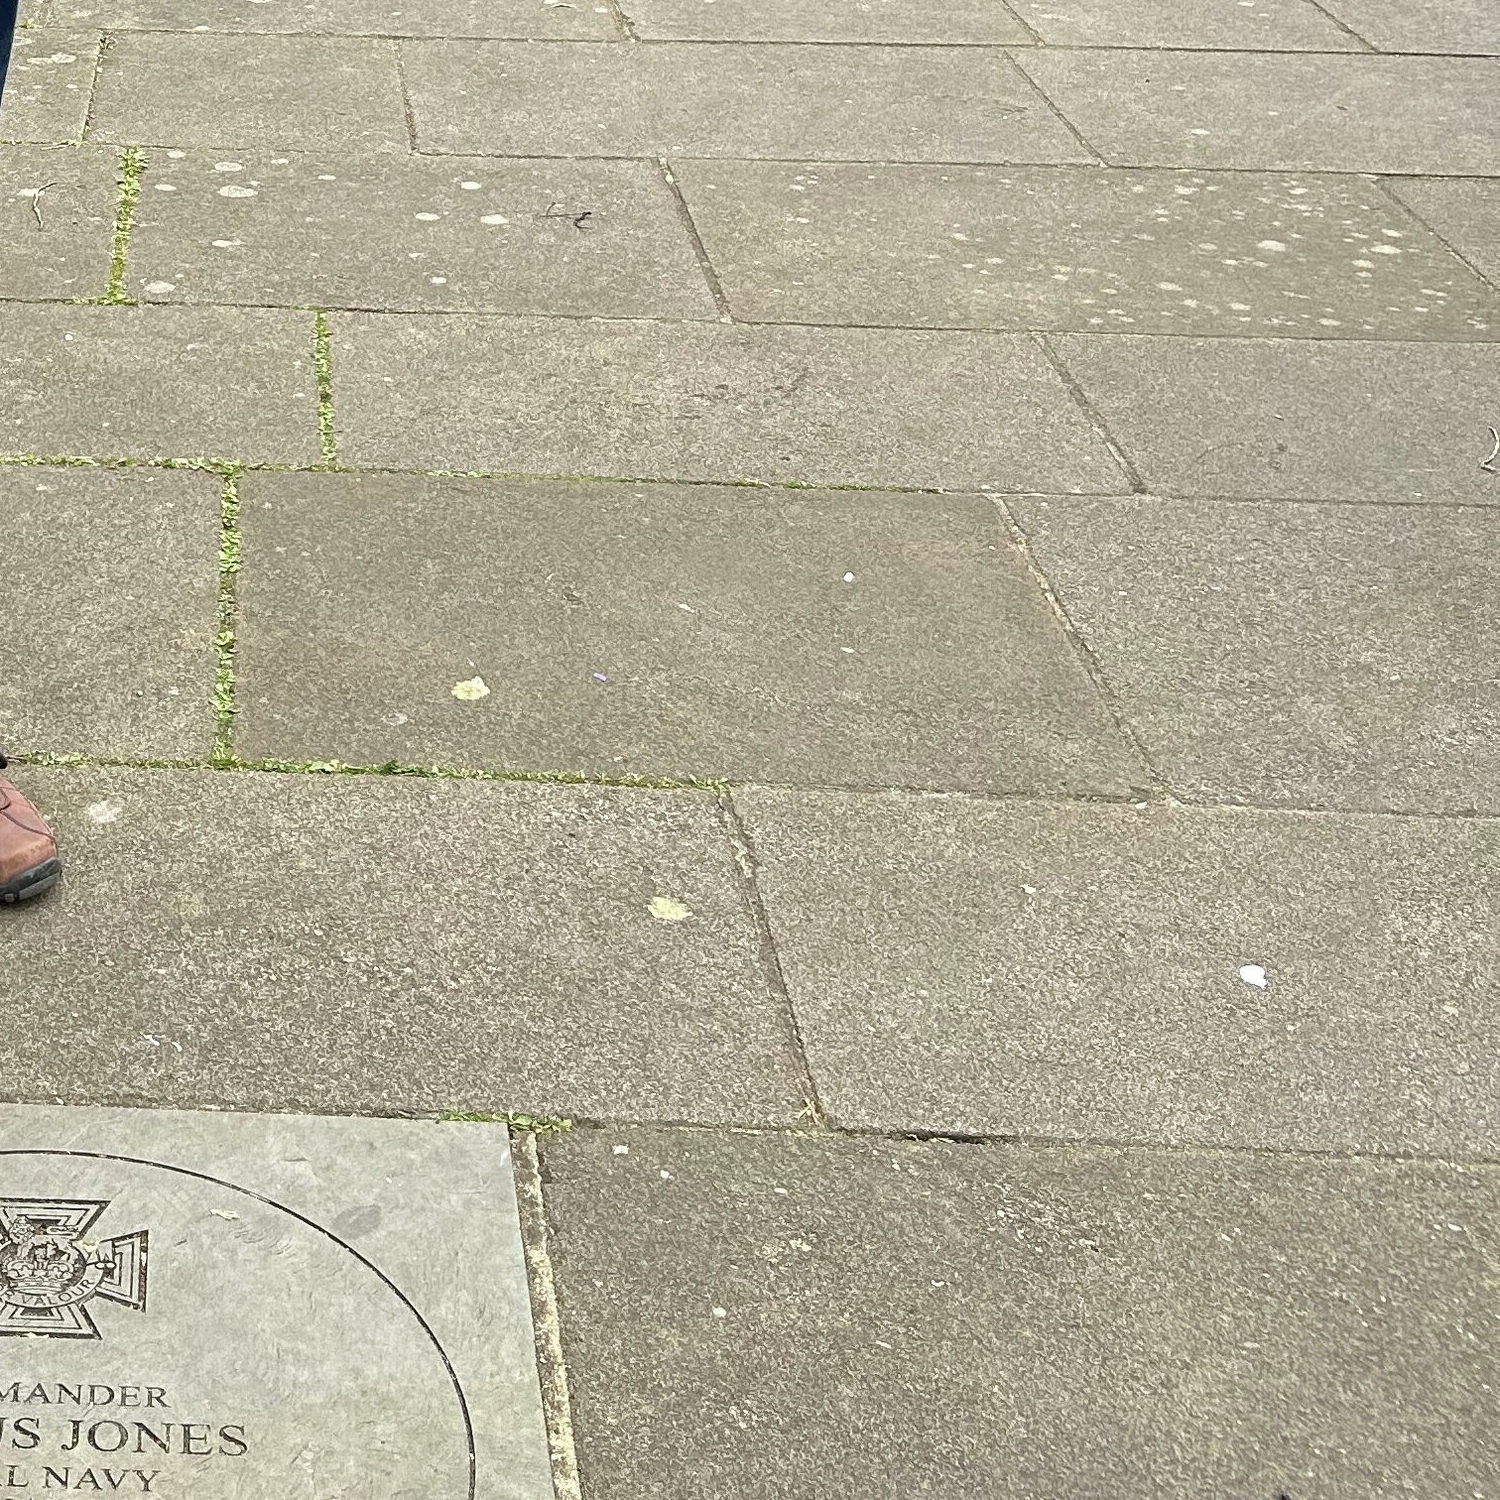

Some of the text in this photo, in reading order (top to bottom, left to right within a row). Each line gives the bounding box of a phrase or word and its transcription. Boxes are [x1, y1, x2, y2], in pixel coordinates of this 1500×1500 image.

[22, 1278, 96, 1306] VALOUR
[61, 1418, 250, 1457] JONES
[42, 1465, 162, 1493] NAVY
